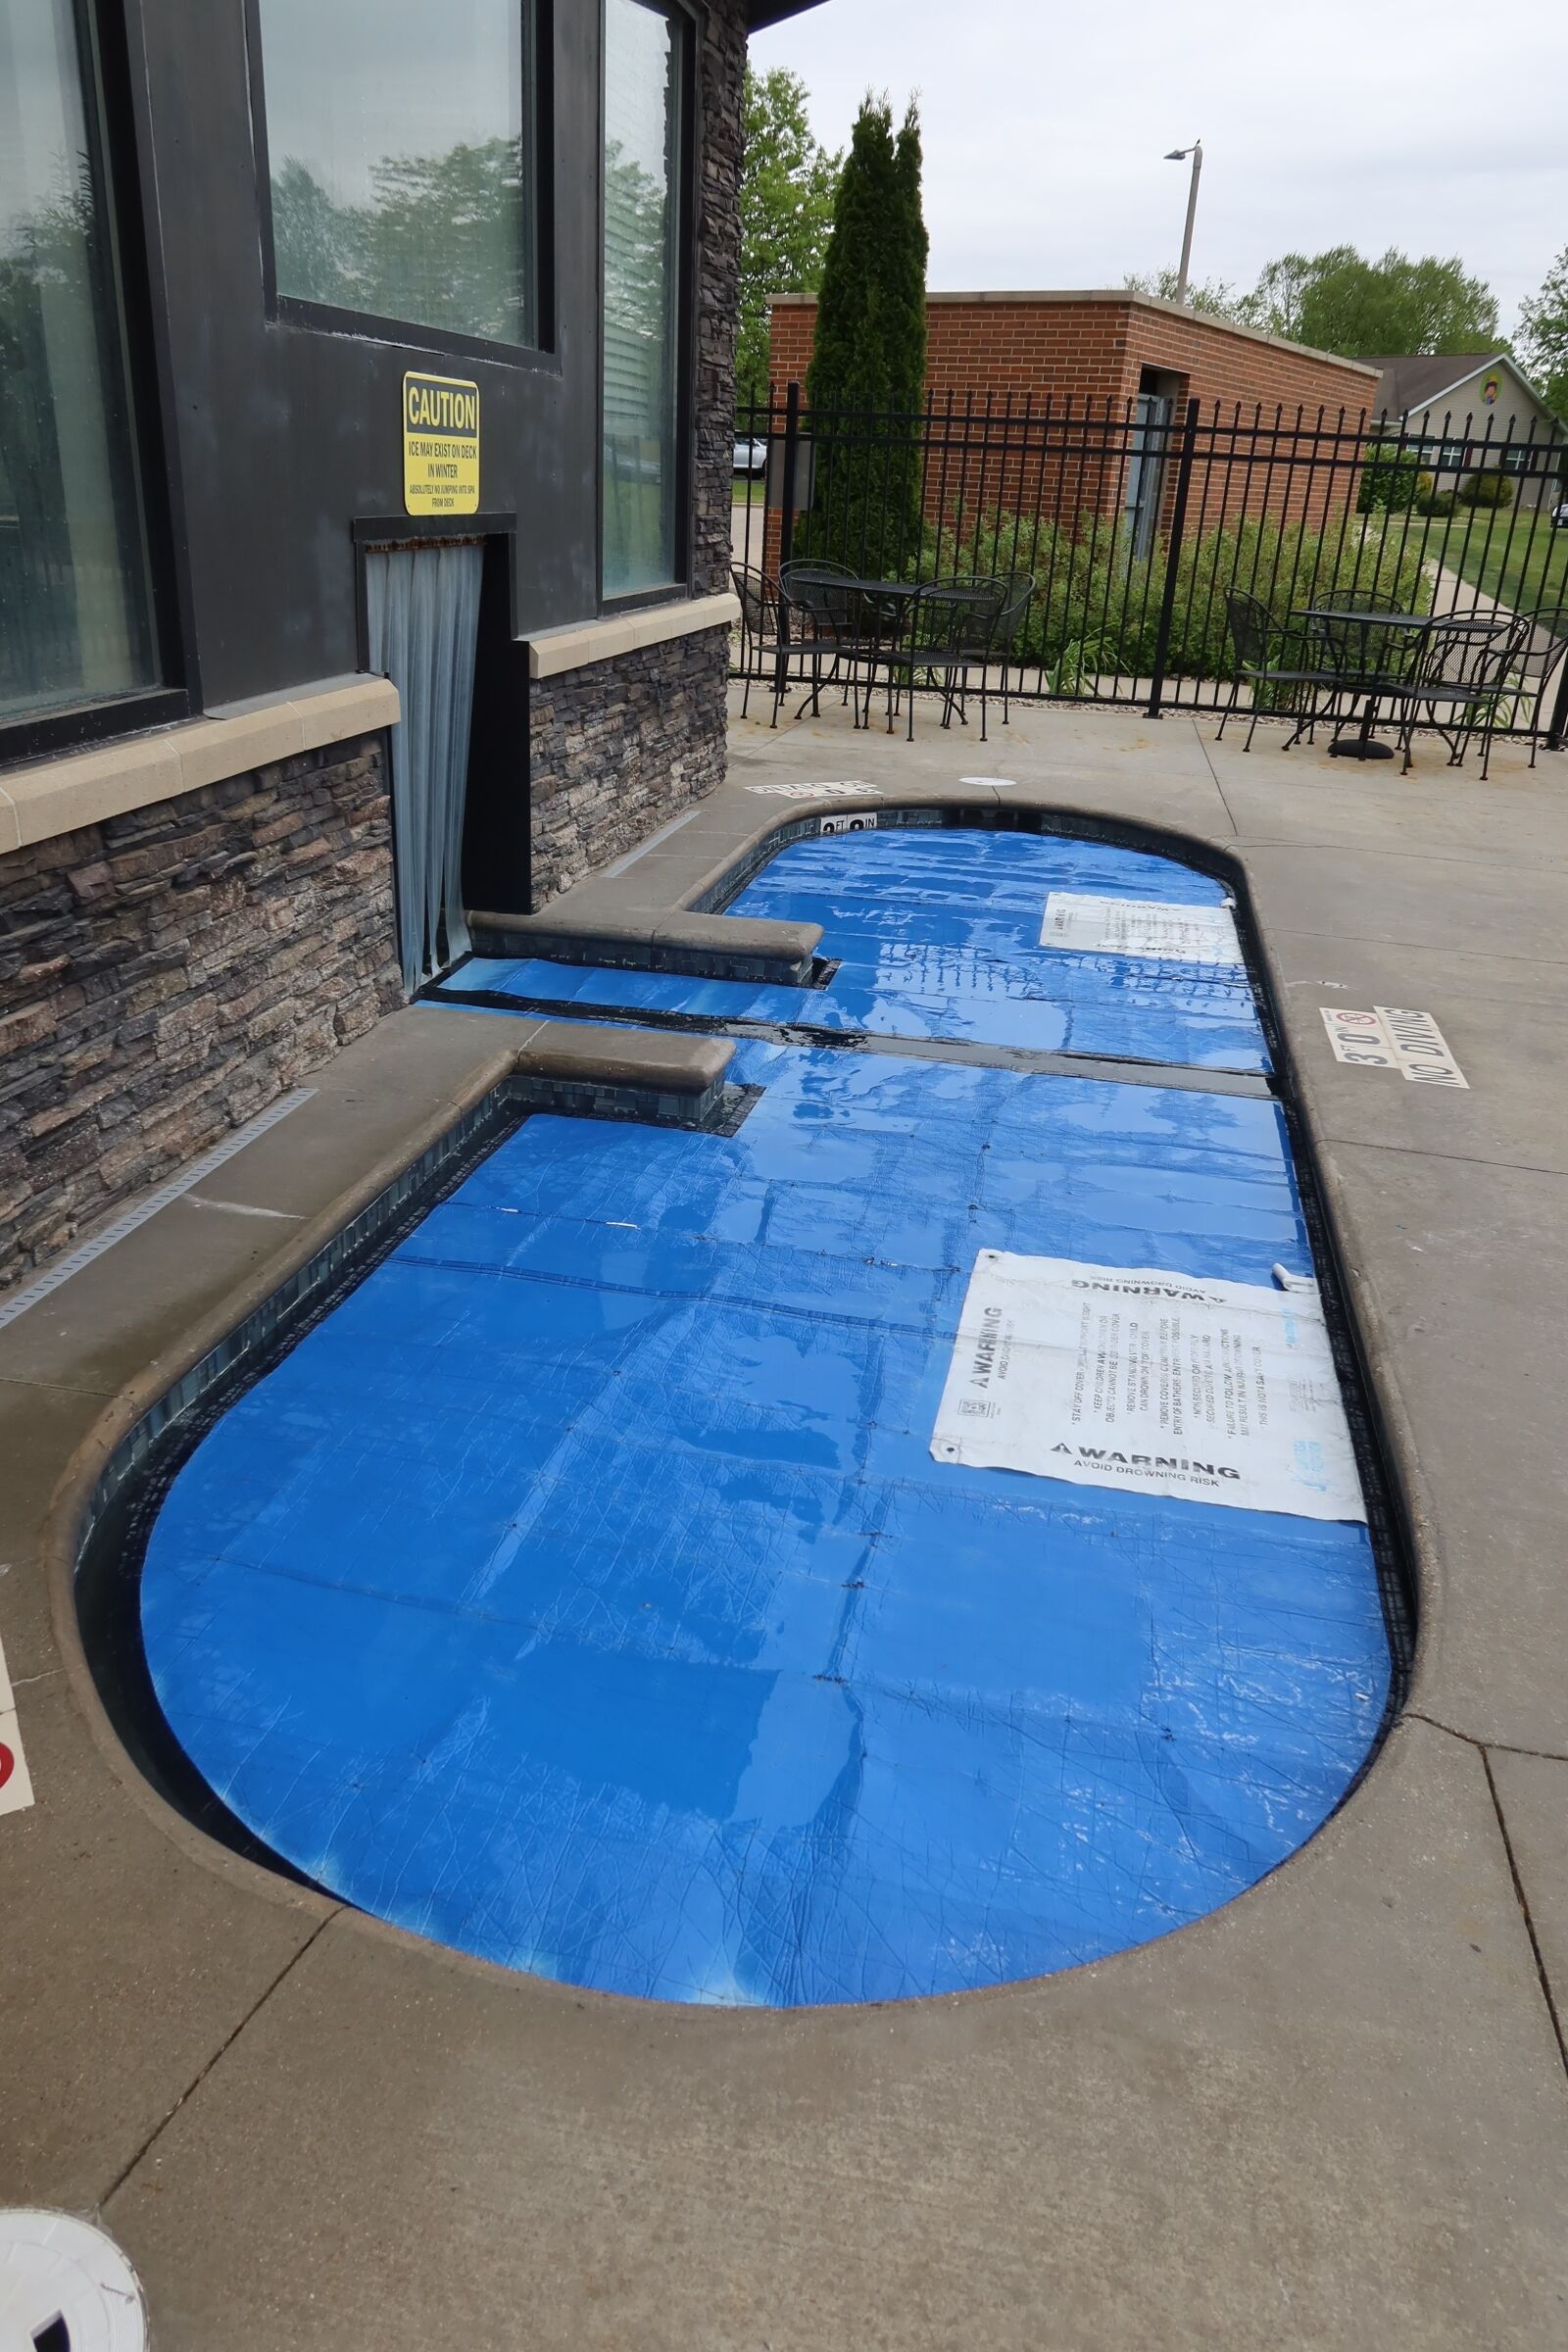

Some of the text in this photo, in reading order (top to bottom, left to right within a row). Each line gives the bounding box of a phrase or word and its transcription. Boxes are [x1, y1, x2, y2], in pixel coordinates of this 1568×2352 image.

[409, 386, 475, 429] CAUTION
[409, 441, 477, 459] ICE MAY EXIST ON DECK
[427, 464, 458, 478] IN WINTER
[410, 484, 433, 494] ABSOLUTELY
[435, 485, 440, 494] NO
[441, 485, 458, 494] JUMPING
[432, 498, 455, 507] FROM DECK
[836, 820, 845, 829] FT
[865, 818, 874, 828] IN
[1337, 1033, 1381, 1045] 0
[1384, 1009, 1460, 1086] NO DIVING
[1344, 1053, 1388, 1065] 3
[1071, 1280, 1205, 1301] WARNING
[1116, 1278, 1172, 1288] DROWNING
[1176, 1284, 1206, 1294] AVOID
[1129, 1323, 1138, 1339] CLD
[1141, 1331, 1150, 1349] COVER
[998, 1362, 1008, 1380] AVOID
[1109, 1361, 1117, 1370] BE
[1192, 1364, 1200, 1374] OR
[1075, 1372, 1084, 1391] COVER
[1095, 1364, 1105, 1394] CDREN
[1107, 1371, 1117, 1396] CANNOT
[1141, 1377, 1150, 1397] DROWN
[1224, 1374, 1233, 1399] FOLLOW
[1172, 1378, 1182, 1406] BATHERS
[1256, 1390, 1266, 1403] NOT
[1094, 1394, 1102, 1409] KEEP
[1140, 1399, 1149, 1411] CAN
[1072, 1405, 1081, 1421] STAY
[1173, 1407, 1182, 1416] OF
[1258, 1411, 1268, 1425] THIS
[1173, 1416, 1182, 1435] ENTRY
[1225, 1409, 1236, 1435] FAILURE
[1078, 1446, 1241, 1480] WARNING
[1074, 1459, 1220, 1488] AVOID DROWNING RISK
